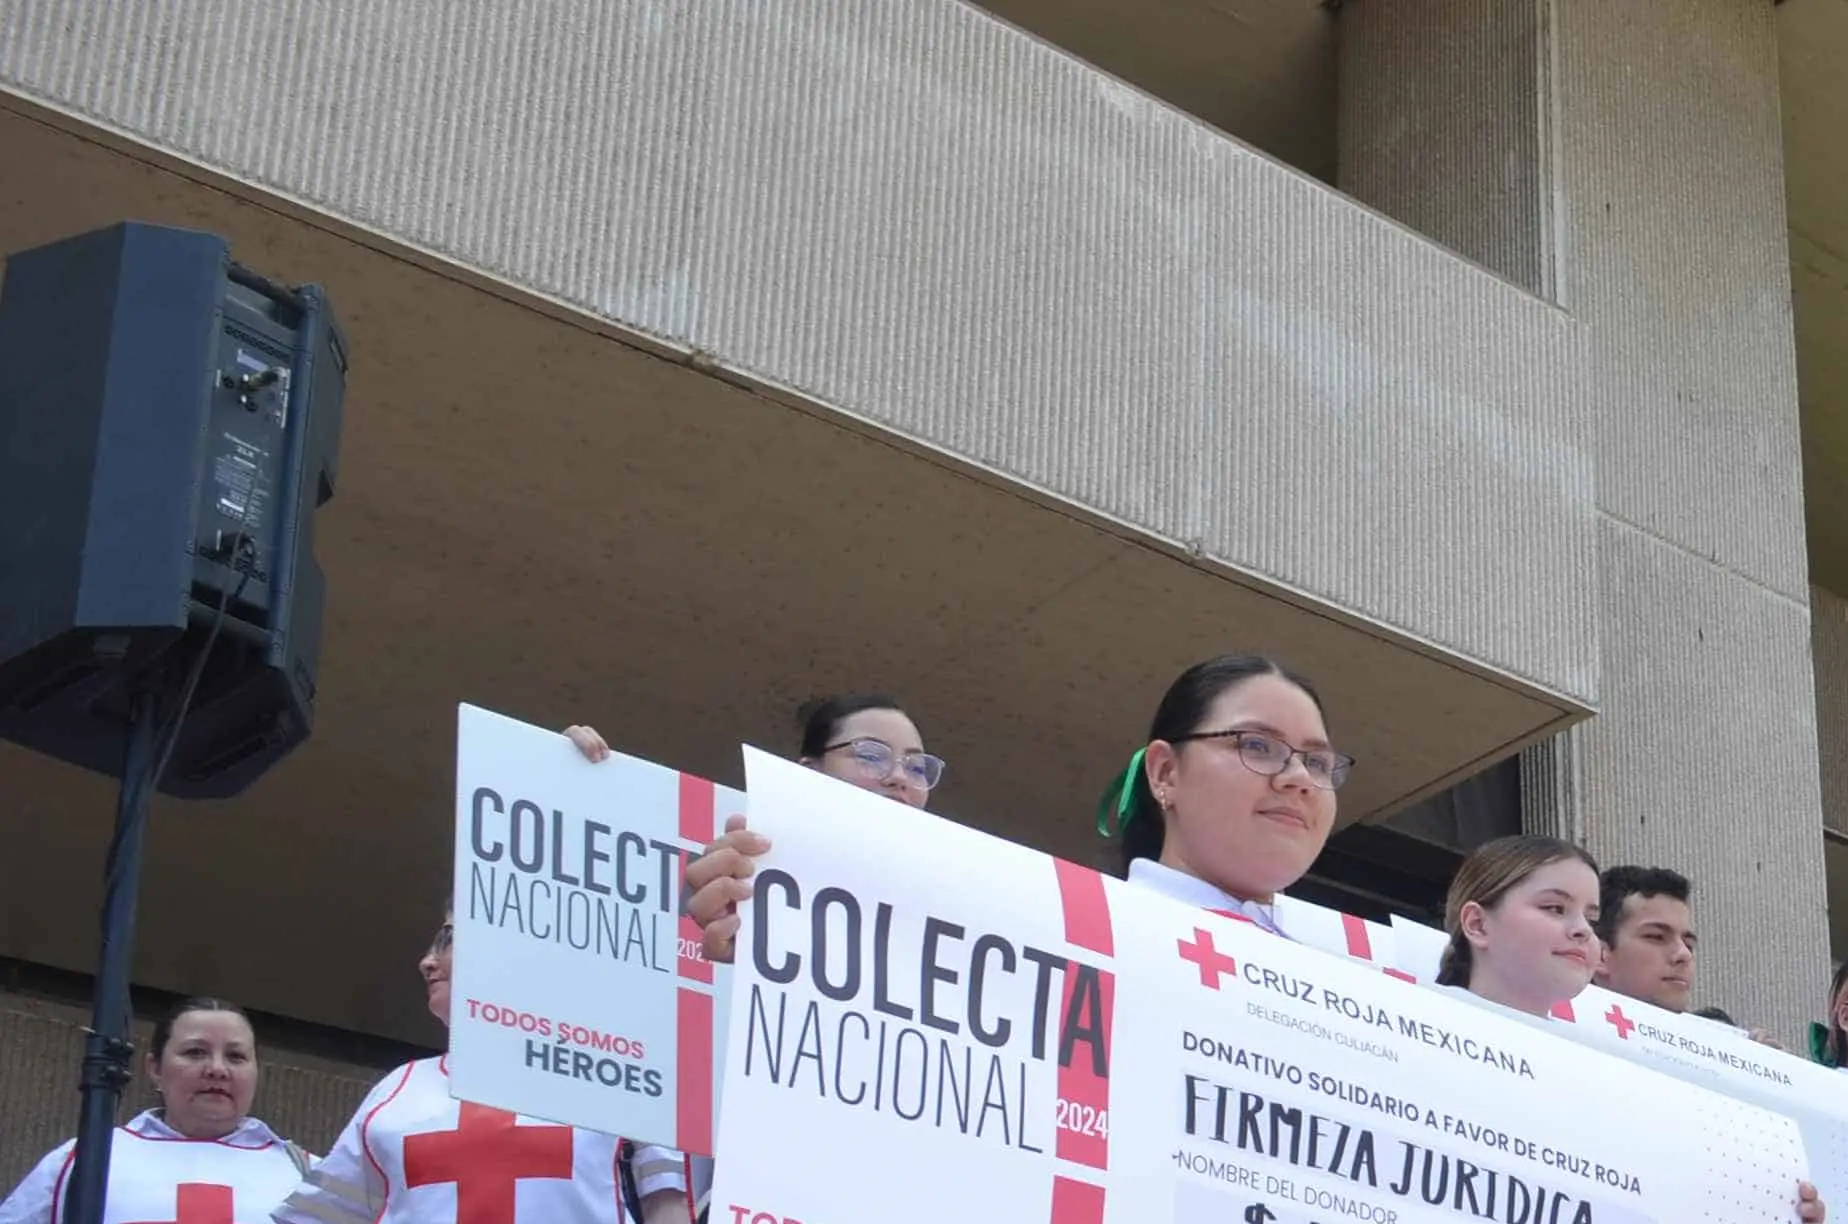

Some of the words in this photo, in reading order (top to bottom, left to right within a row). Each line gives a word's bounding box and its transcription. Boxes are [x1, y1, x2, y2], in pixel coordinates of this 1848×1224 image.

[470, 861, 670, 973] NACIONAL
[677, 938, 713, 965] 202
[752, 869, 1109, 1078] COLECTA
[466, 999, 551, 1036] TODOS
[557, 1022, 645, 1059] SOMOS
[1244, 963, 1316, 1005] CRUZ
[1323, 989, 1393, 1031] ROJA
[1398, 1015, 1535, 1080] MEXICANA
[1638, 1023, 1680, 1047] CRUZ
[1679, 1036, 1715, 1060] ROJA
[1718, 1051, 1792, 1085] MEXICANA
[525, 1034, 663, 1097] HÉROES
[745, 984, 1043, 1154] NACIONAL
[1056, 1098, 1109, 1139] 2024
[1183, 1031, 1302, 1084] DONATIVO
[1309, 1072, 1418, 1121] SOLIDARIO
[1425, 1110, 1438, 1129] A
[1444, 1115, 1509, 1150] FAVOR
[1515, 1138, 1537, 1160] DE
[1542, 1148, 1590, 1177] CRUZ
[1595, 1164, 1641, 1195] ROJA
[1185, 1074, 1377, 1187] FIRMEZA
[1177, 1151, 1259, 1189] NOMBRE
[1266, 1176, 1298, 1201] DEL
